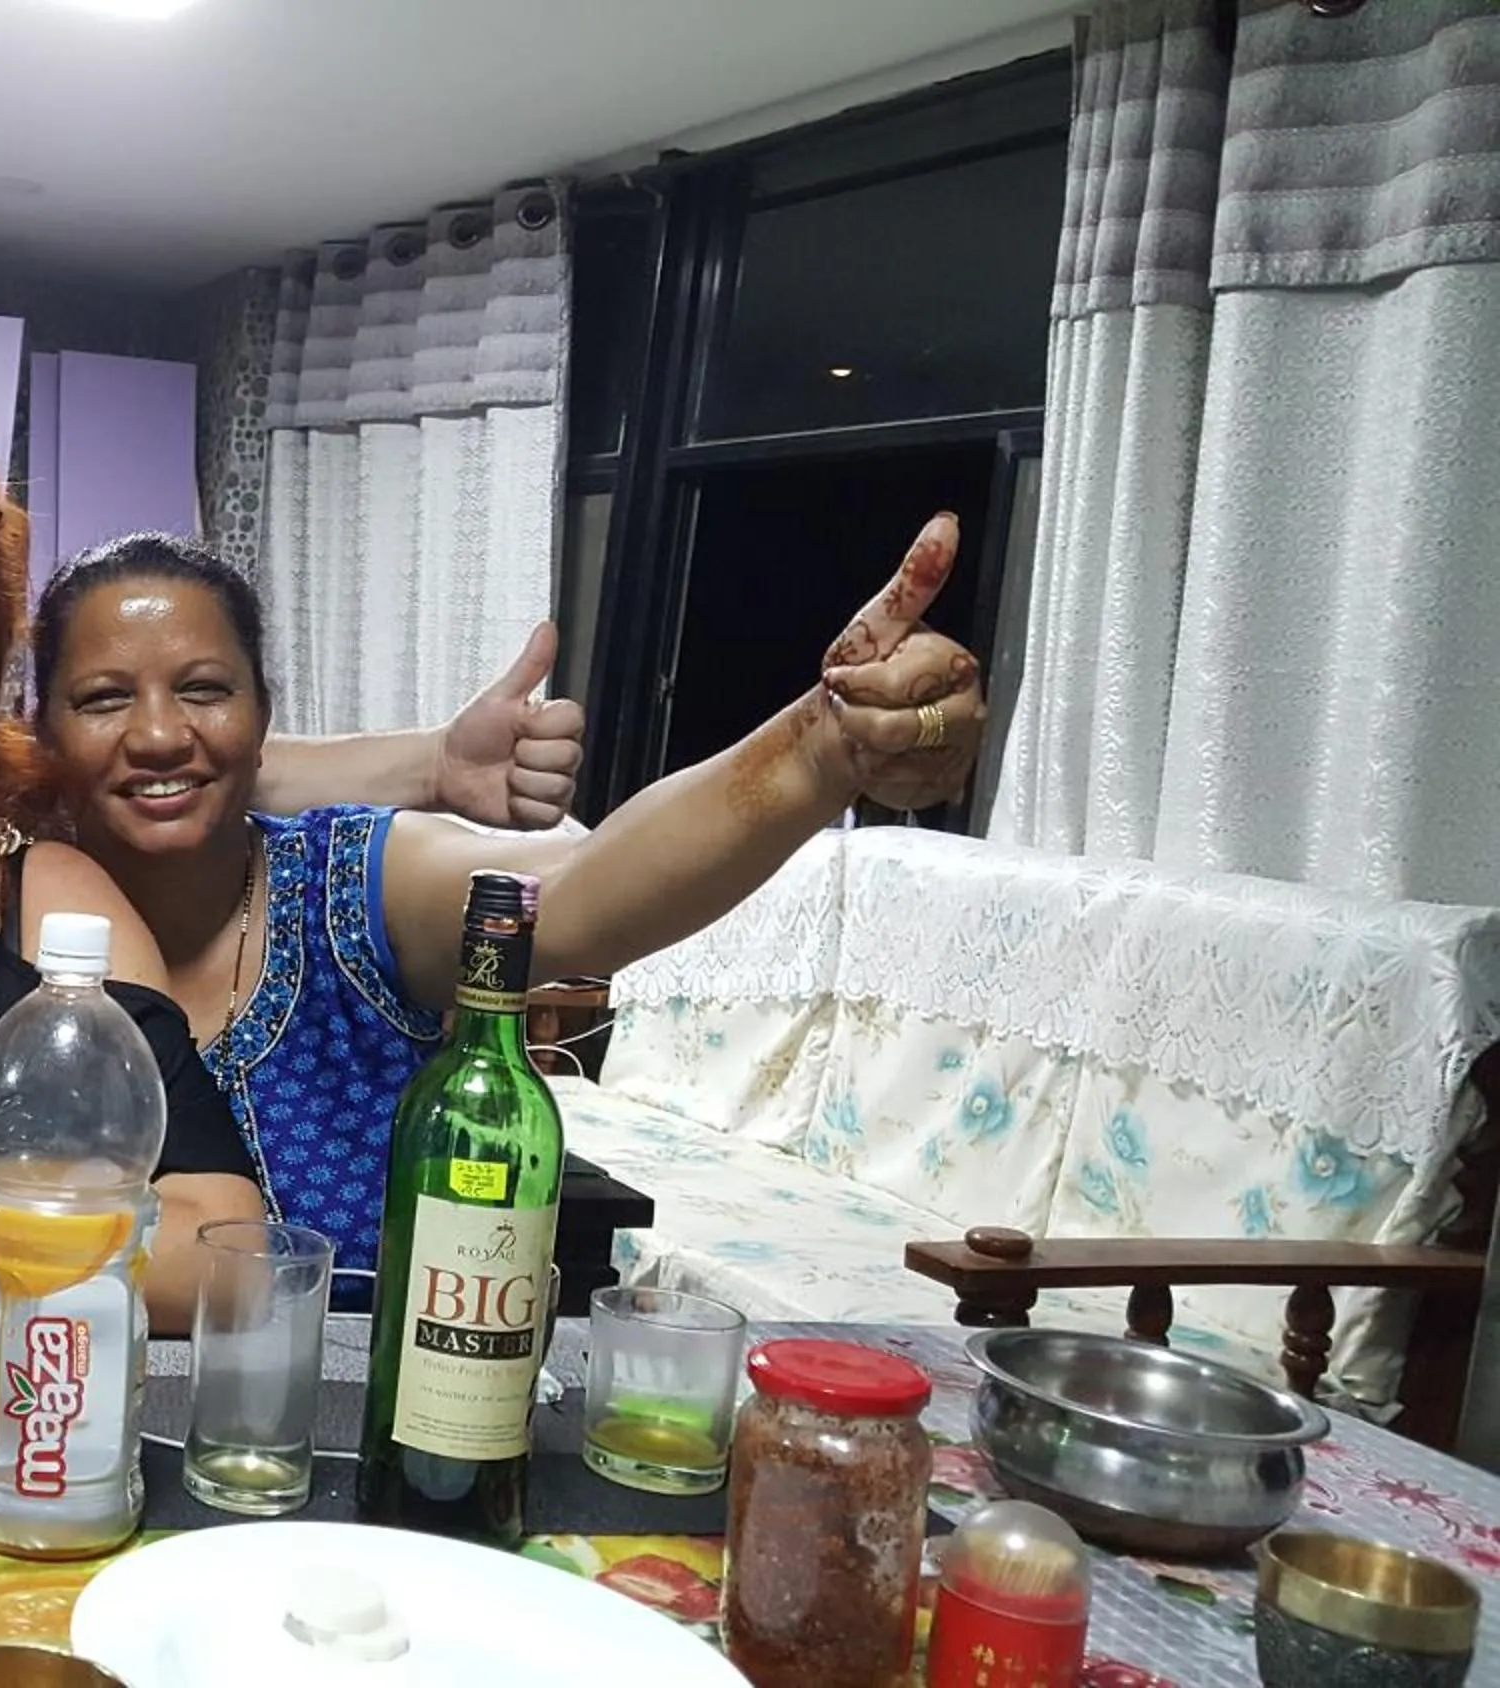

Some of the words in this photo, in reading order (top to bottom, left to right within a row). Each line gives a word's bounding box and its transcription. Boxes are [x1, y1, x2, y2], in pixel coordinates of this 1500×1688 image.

[419, 1265, 537, 1328] BIG
[419, 1323, 531, 1355] MASTER
[21, 1320, 80, 1494] maaza
